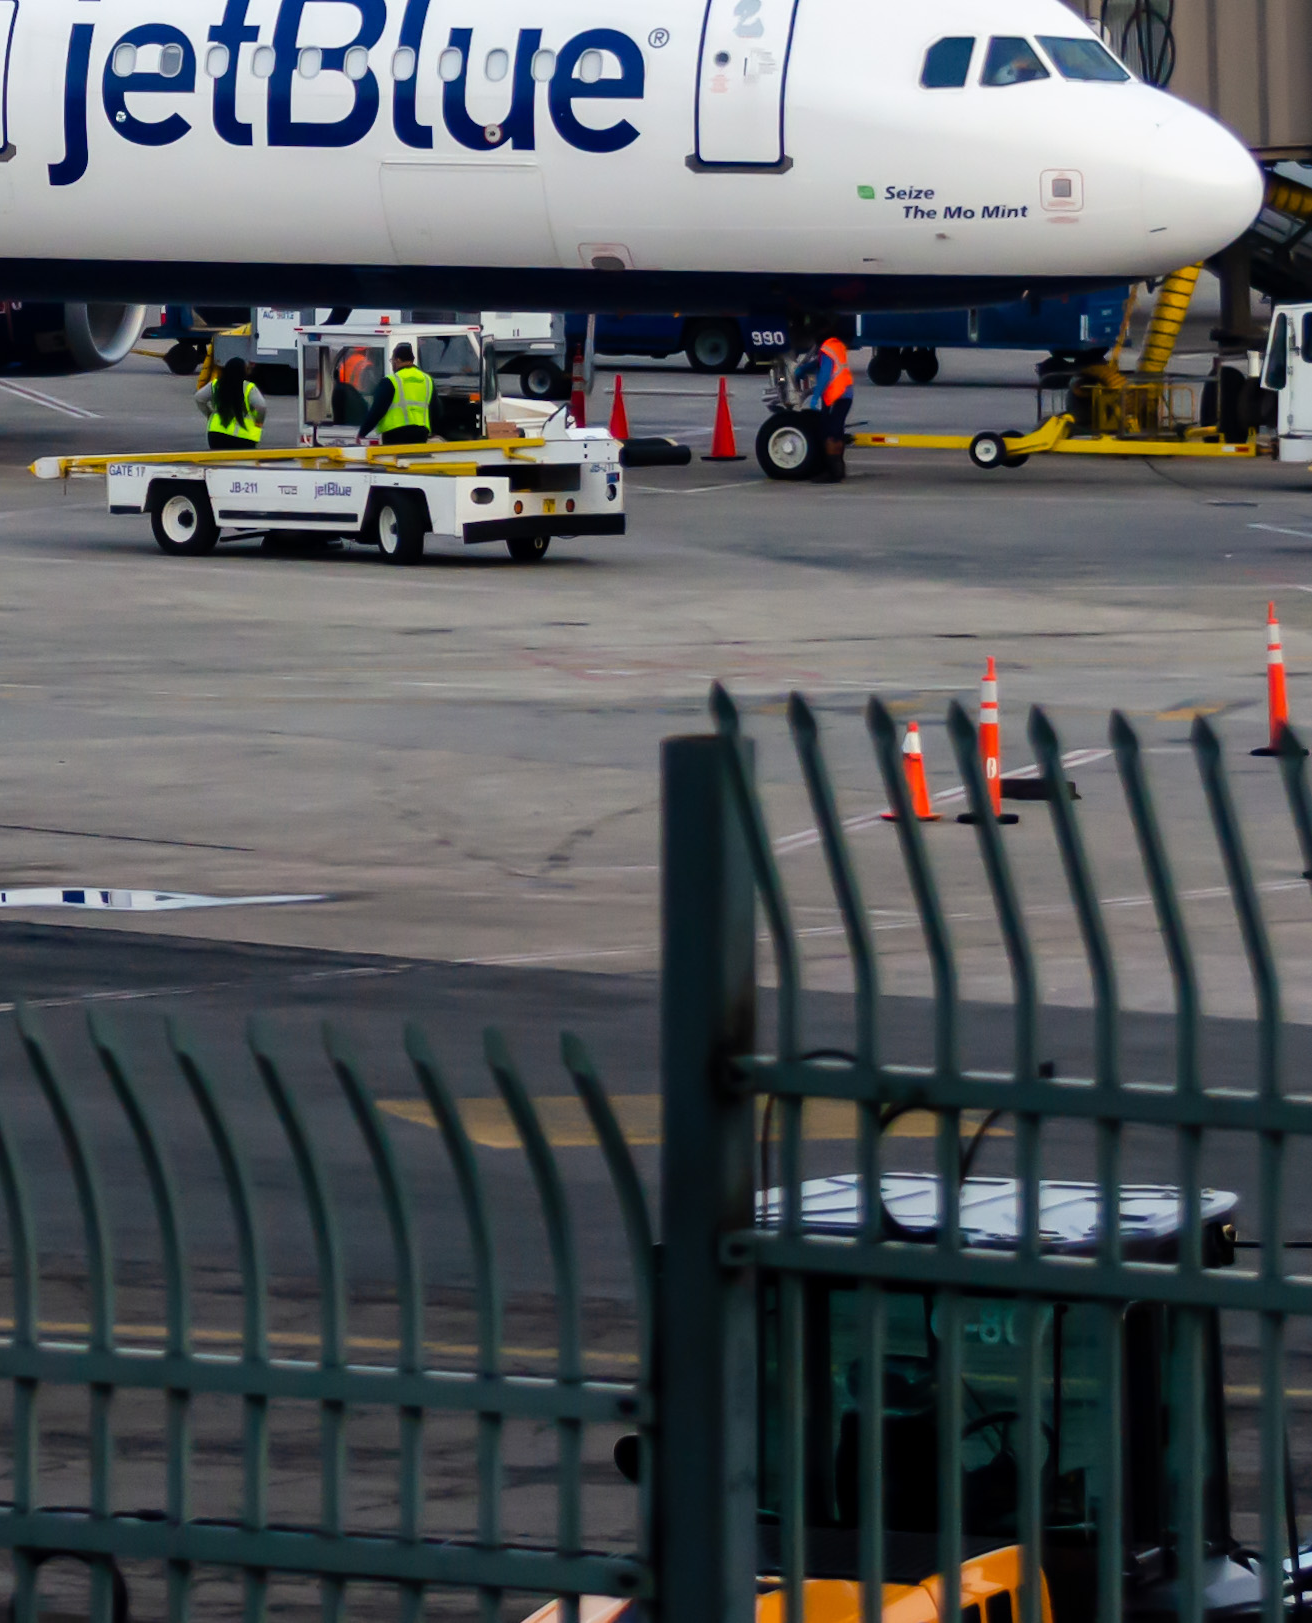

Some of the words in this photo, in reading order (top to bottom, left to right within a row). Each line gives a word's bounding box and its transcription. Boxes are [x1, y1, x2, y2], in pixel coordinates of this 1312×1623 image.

[884, 185, 935, 200] Seize
[904, 205, 937, 219] The
[943, 206, 975, 219] Mo
[981, 205, 1028, 219] Mint
[751, 331, 785, 346] 990
[109, 463, 133, 477] GATE
[229, 481, 258, 494] JB-211
